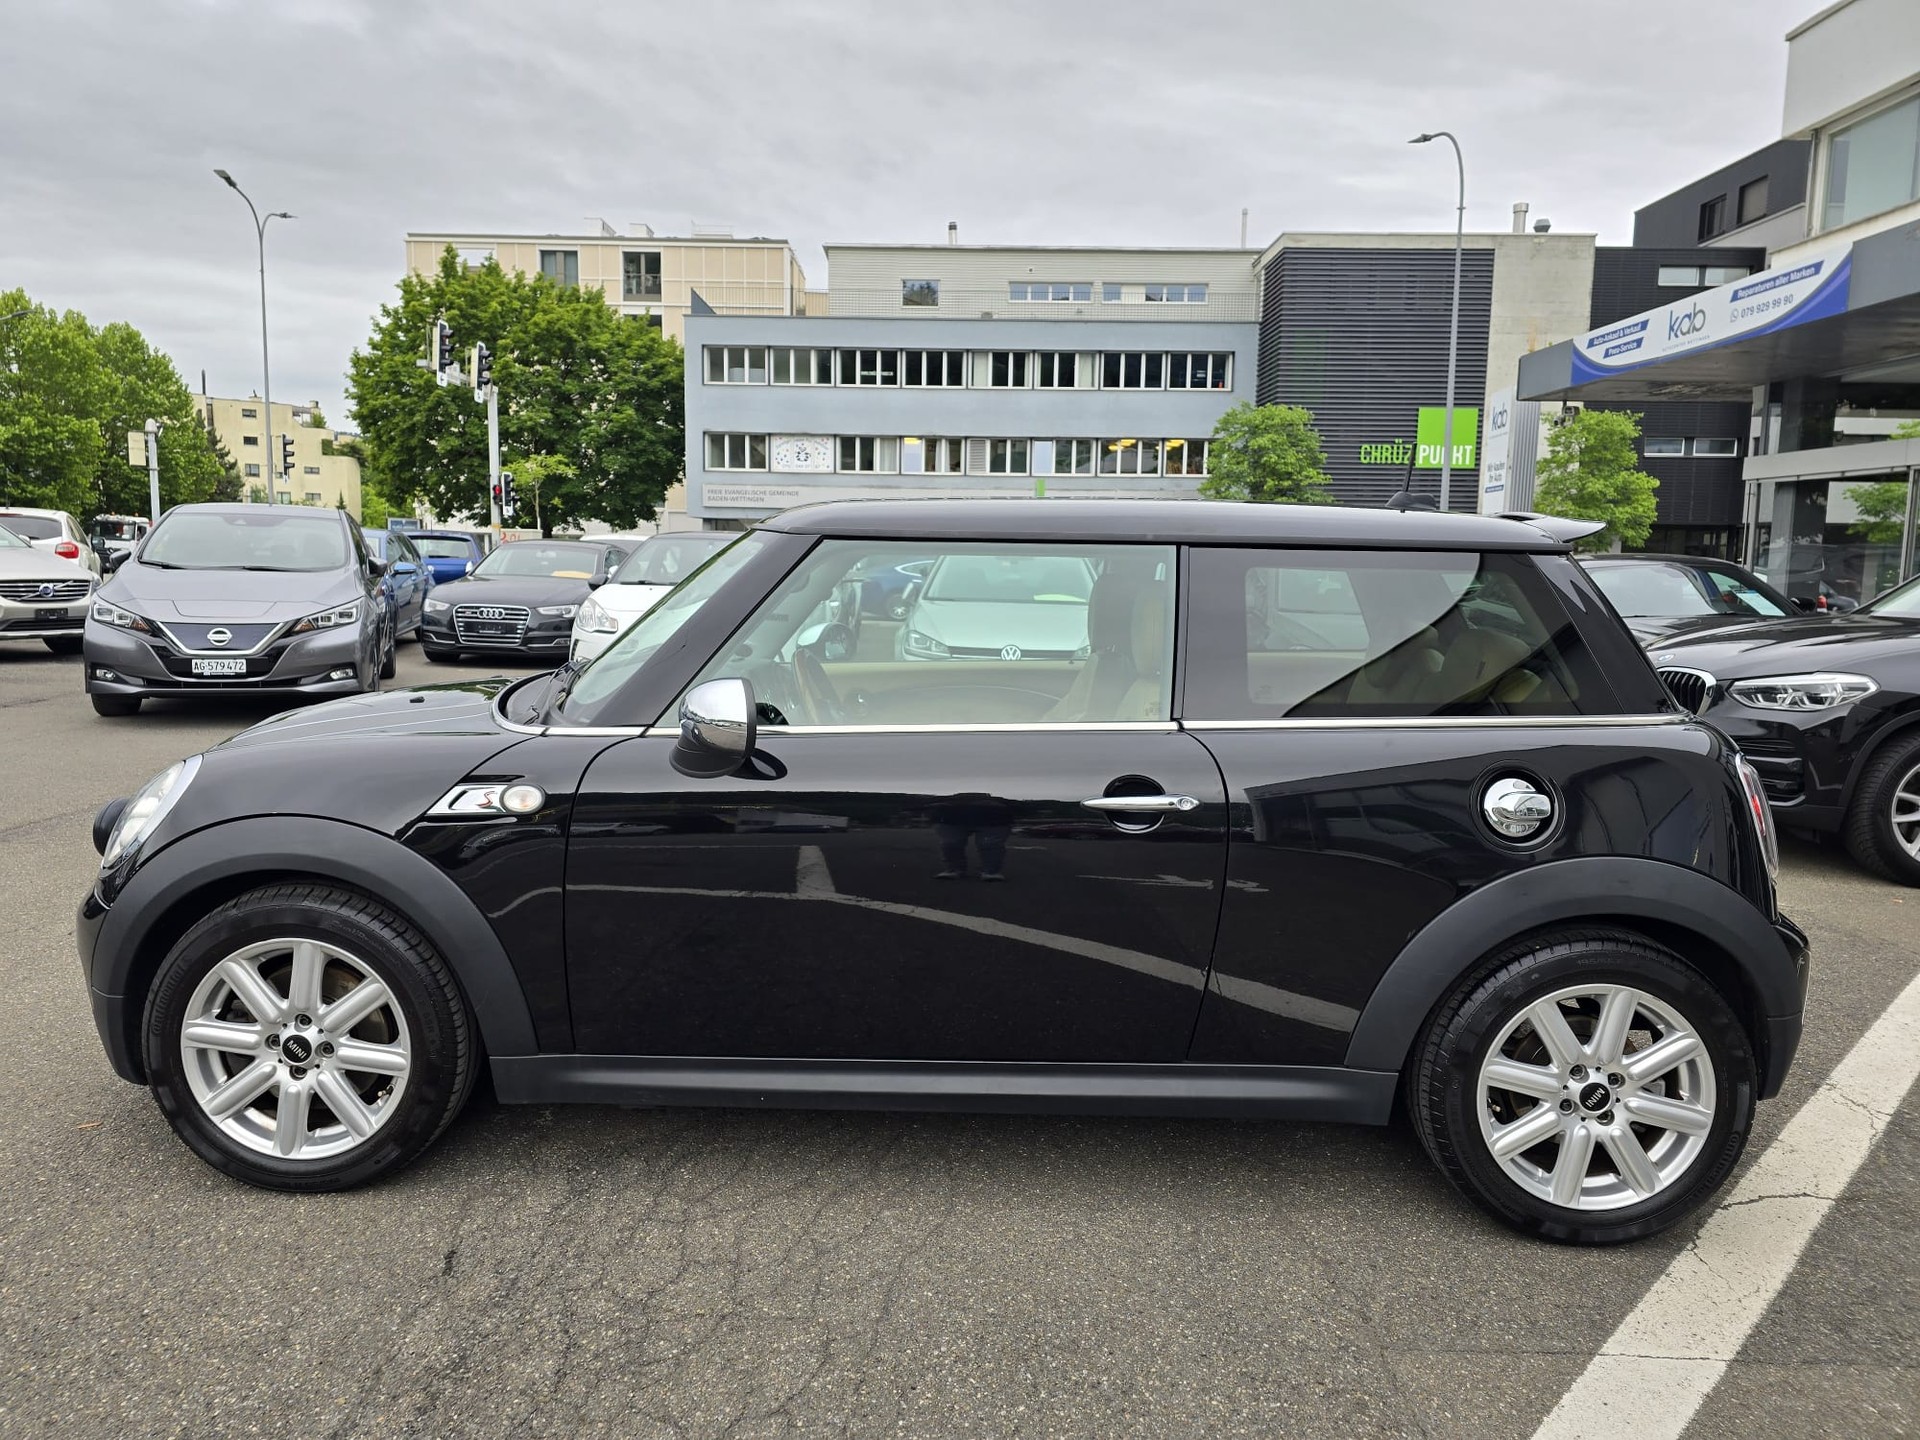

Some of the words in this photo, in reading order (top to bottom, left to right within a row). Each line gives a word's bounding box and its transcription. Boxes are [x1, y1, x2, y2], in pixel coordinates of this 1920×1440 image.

[1738, 280, 1775, 299] Reparaturen
[1790, 266, 1815, 283] Marken
[1740, 305, 1755, 319] 079
[1756, 301, 1770, 314] 929
[1772, 297, 1782, 309] 99
[1783, 293, 1794, 306] 90
[1668, 302, 1706, 341] kab
[1491, 402, 1508, 432] kab
[724, 488, 767, 496] EVANGELISCHE
[768, 489, 799, 497] GEMEINDE
[193, 661, 206, 671] AG
[287, 1040, 307, 1059] MINI
[1585, 1087, 1605, 1108] MINI
